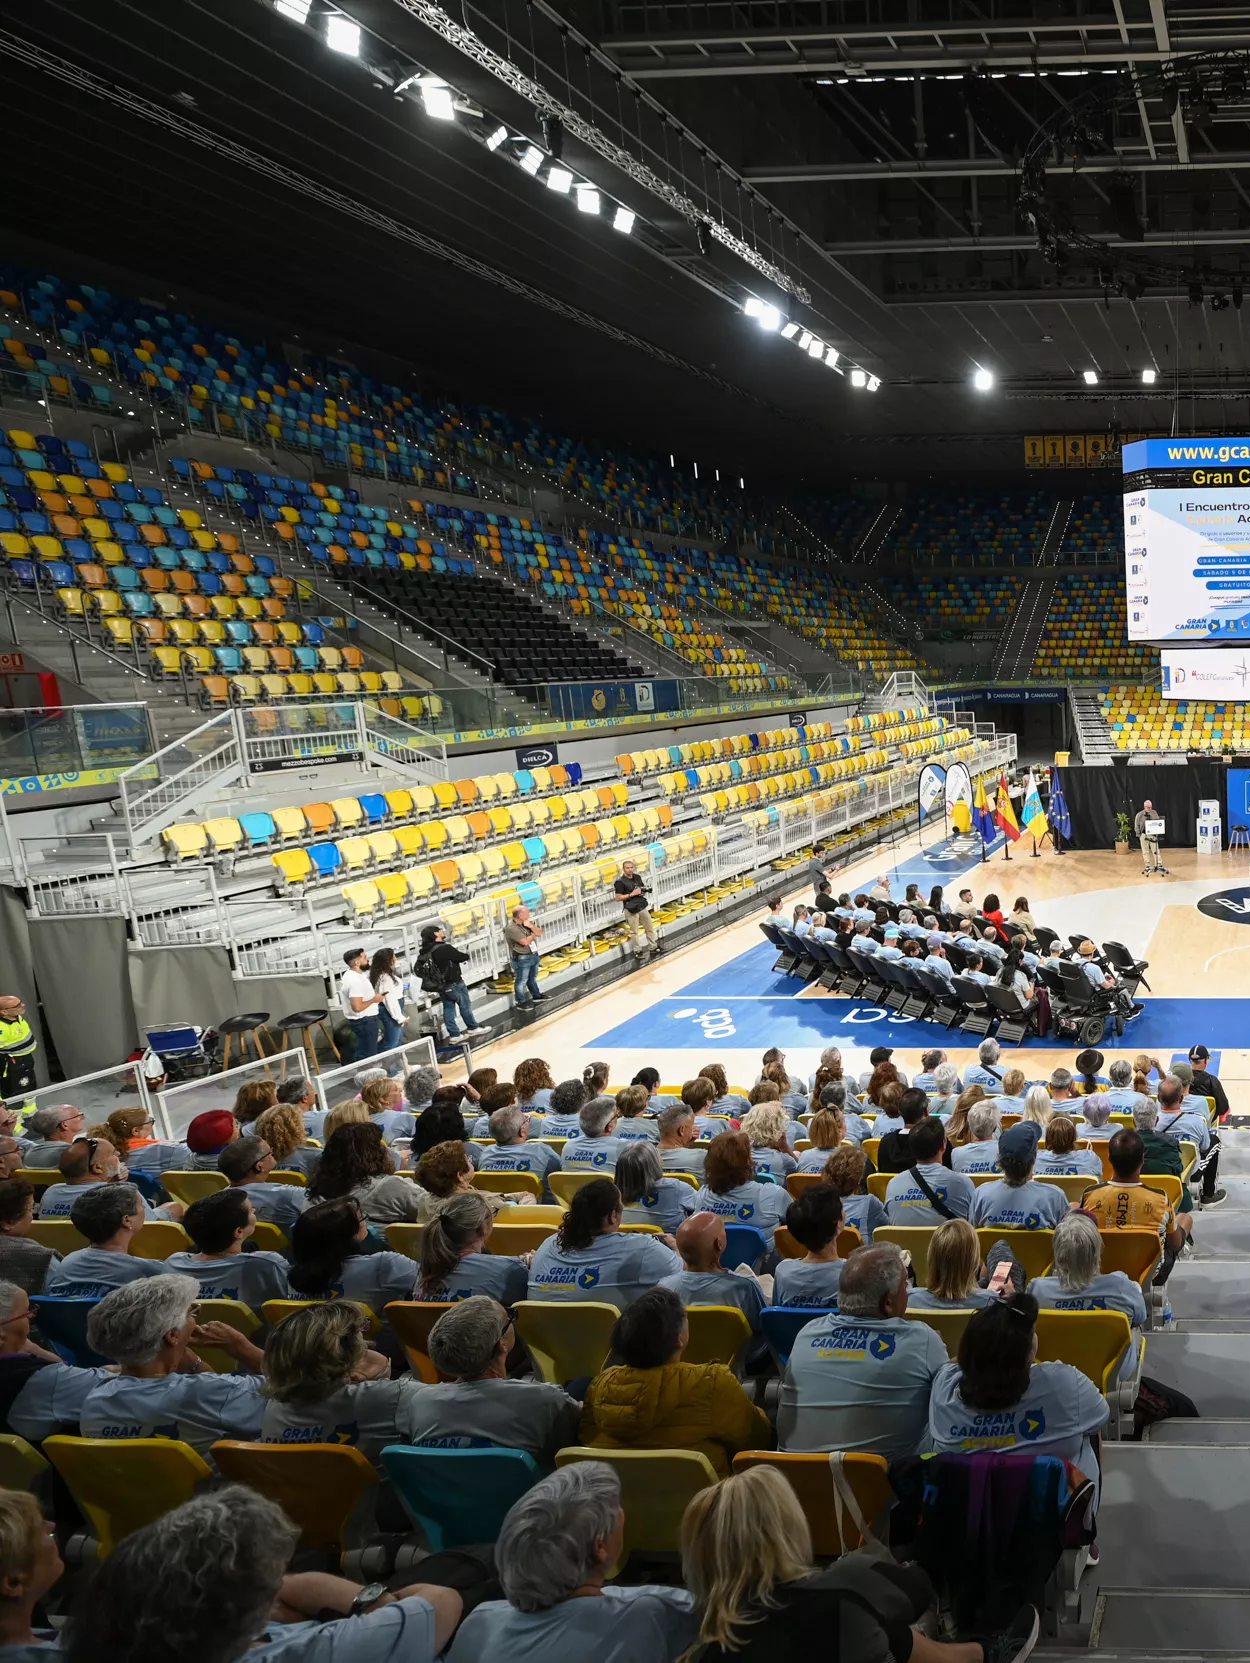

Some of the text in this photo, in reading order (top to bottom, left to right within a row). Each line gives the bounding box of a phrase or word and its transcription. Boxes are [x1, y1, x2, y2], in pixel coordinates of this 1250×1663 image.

[1192, 470, 1233, 484] Gran
[1186, 502, 1250, 511] Encuentro
[281, 757, 337, 767] mezzobespoke.com
[522, 754, 548, 765] DIELCA
[700, 1207, 737, 1216] CANARIA
[713, 1202, 738, 1210] GRAN
[550, 1267, 579, 1275] GRAN
[535, 1274, 576, 1283] CANARIA
[793, 1296, 823, 1304] GRAN
[1055, 1300, 1085, 1309] GRAN
[831, 1328, 871, 1339] GRAN
[811, 1338, 868, 1350] CANARIA
[973, 1411, 1016, 1425] GRAN
[101, 1425, 141, 1438] GRAN
[283, 1426, 324, 1438] GRAN
[949, 1423, 1016, 1437] CANARIA
[961, 1436, 1017, 1449] ACTIVA
